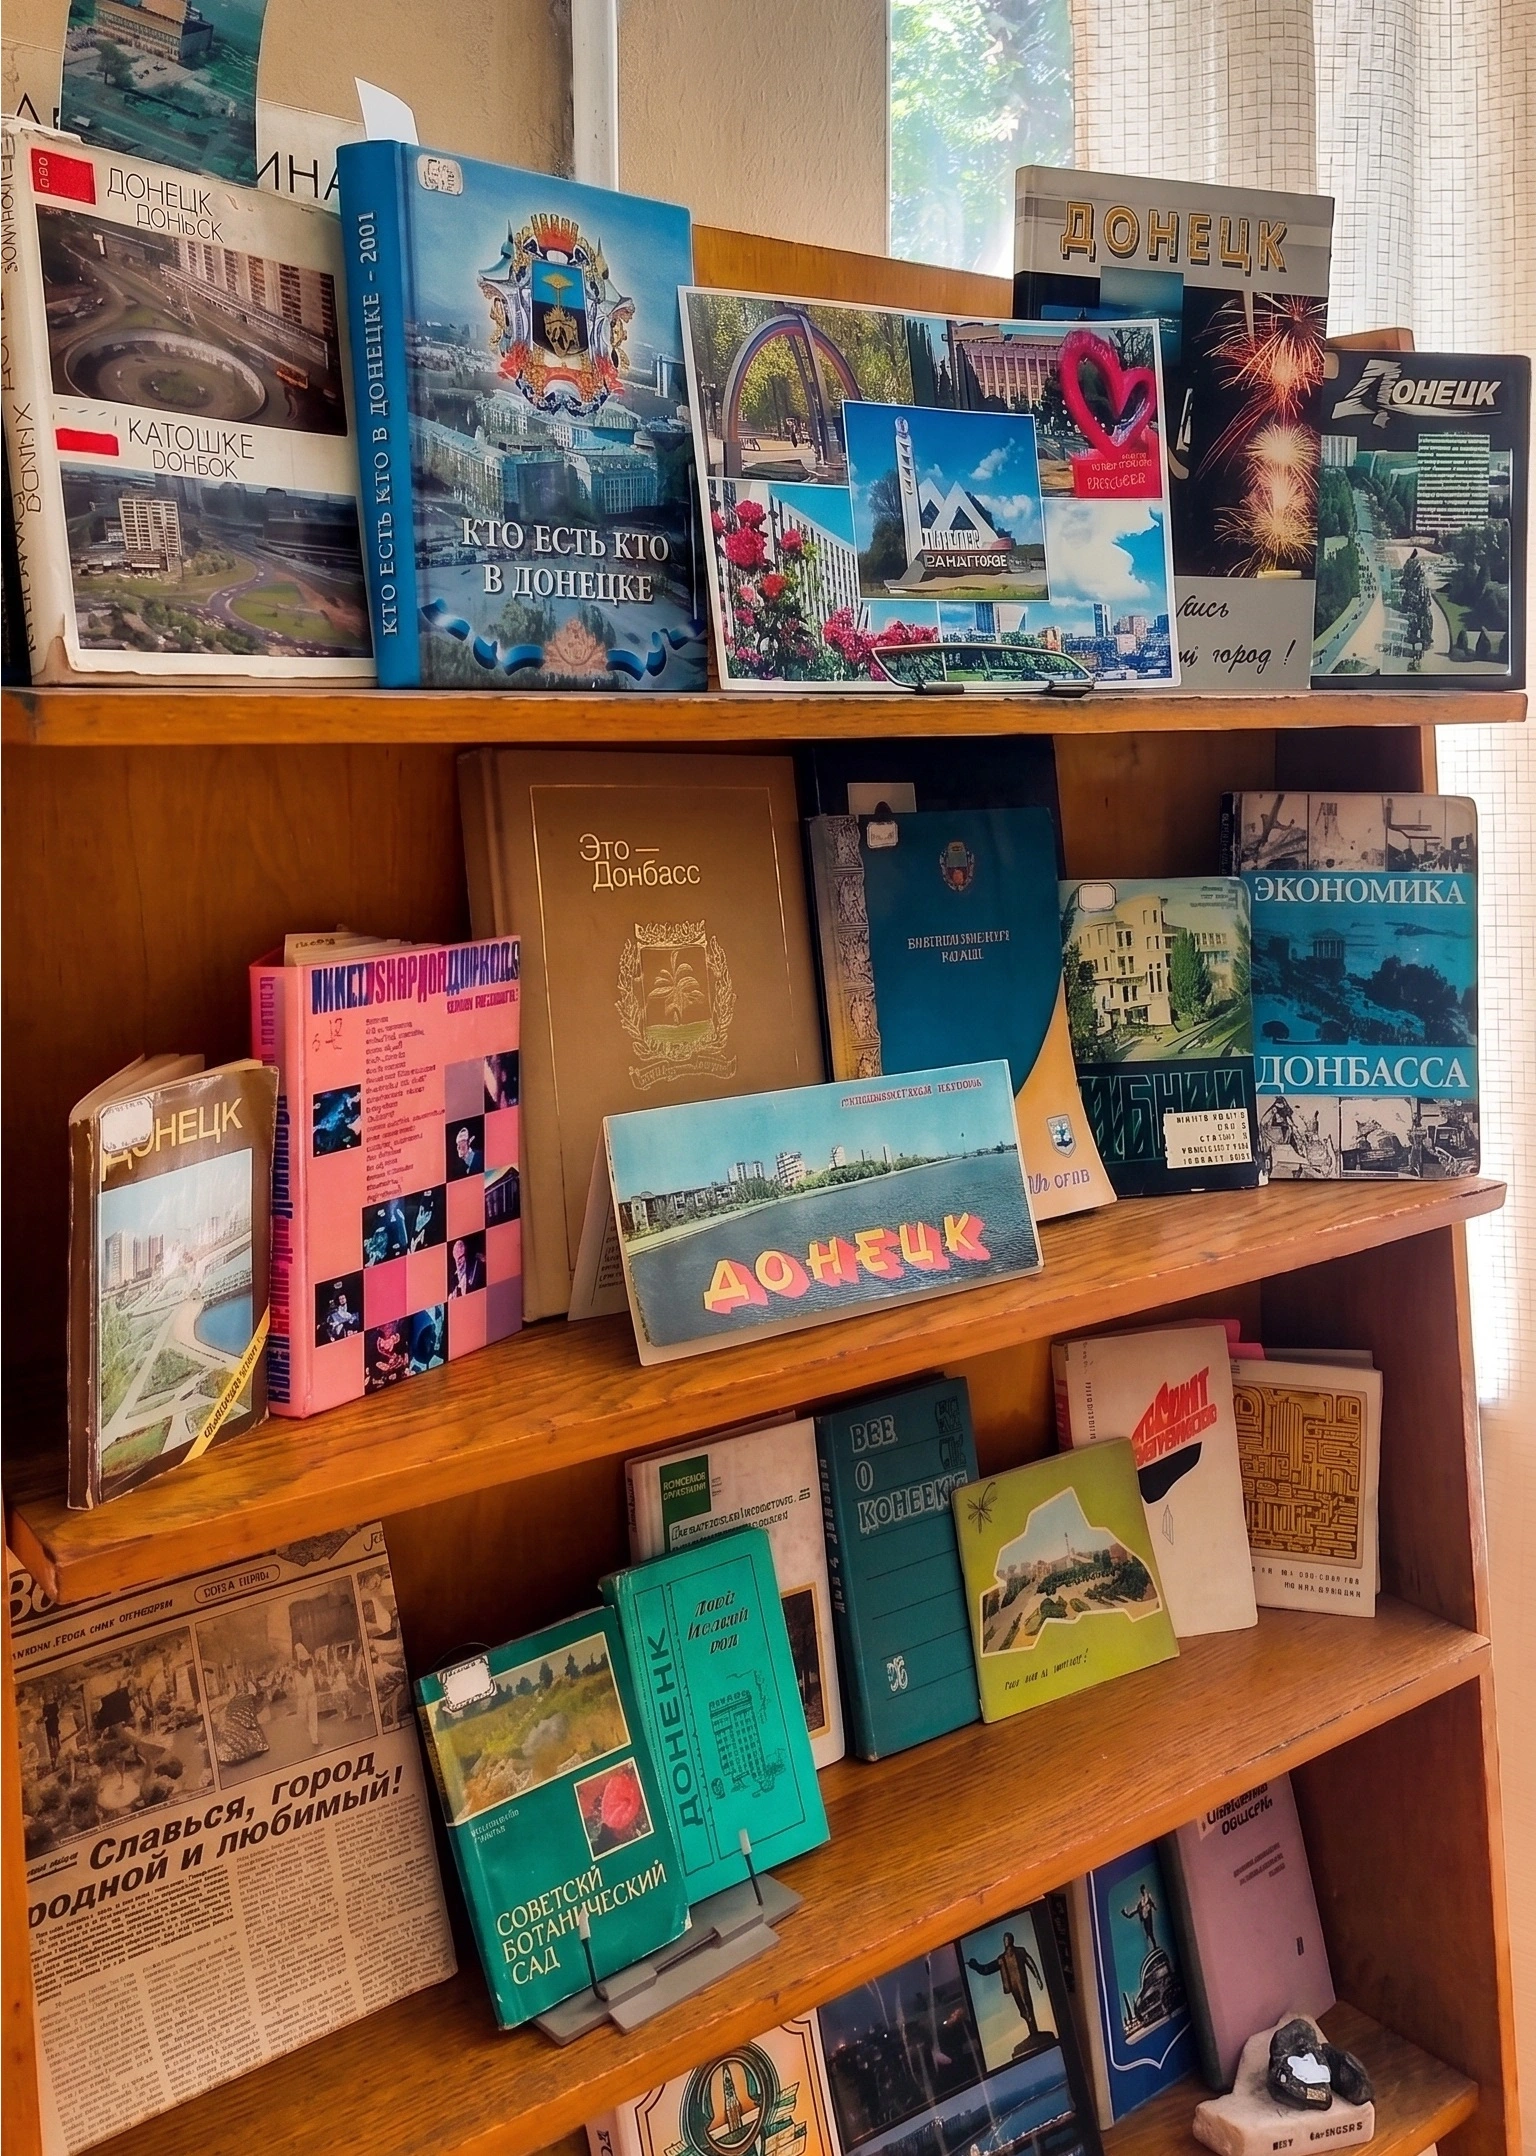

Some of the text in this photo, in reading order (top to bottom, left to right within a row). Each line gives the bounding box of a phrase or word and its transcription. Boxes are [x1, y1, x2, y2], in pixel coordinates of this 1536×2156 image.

[107, 167, 213, 217] ДОНЕЦК
[358, 211, 377, 263] 2001
[1060, 200, 1288, 277] ДОНЕЦК
[362, 292, 389, 416] ДОНЕЦКЕ
[1332, 360, 1501, 428] ДОНЕЦК
[128, 417, 255, 459] КАТОШКЕ
[372, 427, 388, 441] В
[373, 452, 391, 505] КТО
[376, 512, 395, 575] ЕСТЬ
[461, 517, 669, 561] КТО ЕСТЬ КТО
[380, 584, 397, 635] КТО
[483, 564, 654, 607] В ДОНЕЦКЕ
[1212, 644, 1272, 675] город
[579, 833, 630, 861] Это
[592, 859, 701, 892] Донбасс
[1254, 876, 1467, 905] ЭКОНОМИКА
[1256, 1055, 1470, 1093] ДОНБАССА
[703, 1212, 991, 1315] ДОНЕЦК
[647, 1626, 704, 1827] ДОНЕНК
[88, 1751, 377, 1870] Славься, город
[28, 1852, 168, 1929] родной
[179, 1847, 202, 1871] и
[215, 1766, 403, 1859] любимый!
[502, 1859, 668, 1964] БОТАНИЧЕСКИЙ
[512, 1946, 561, 1985] САД
